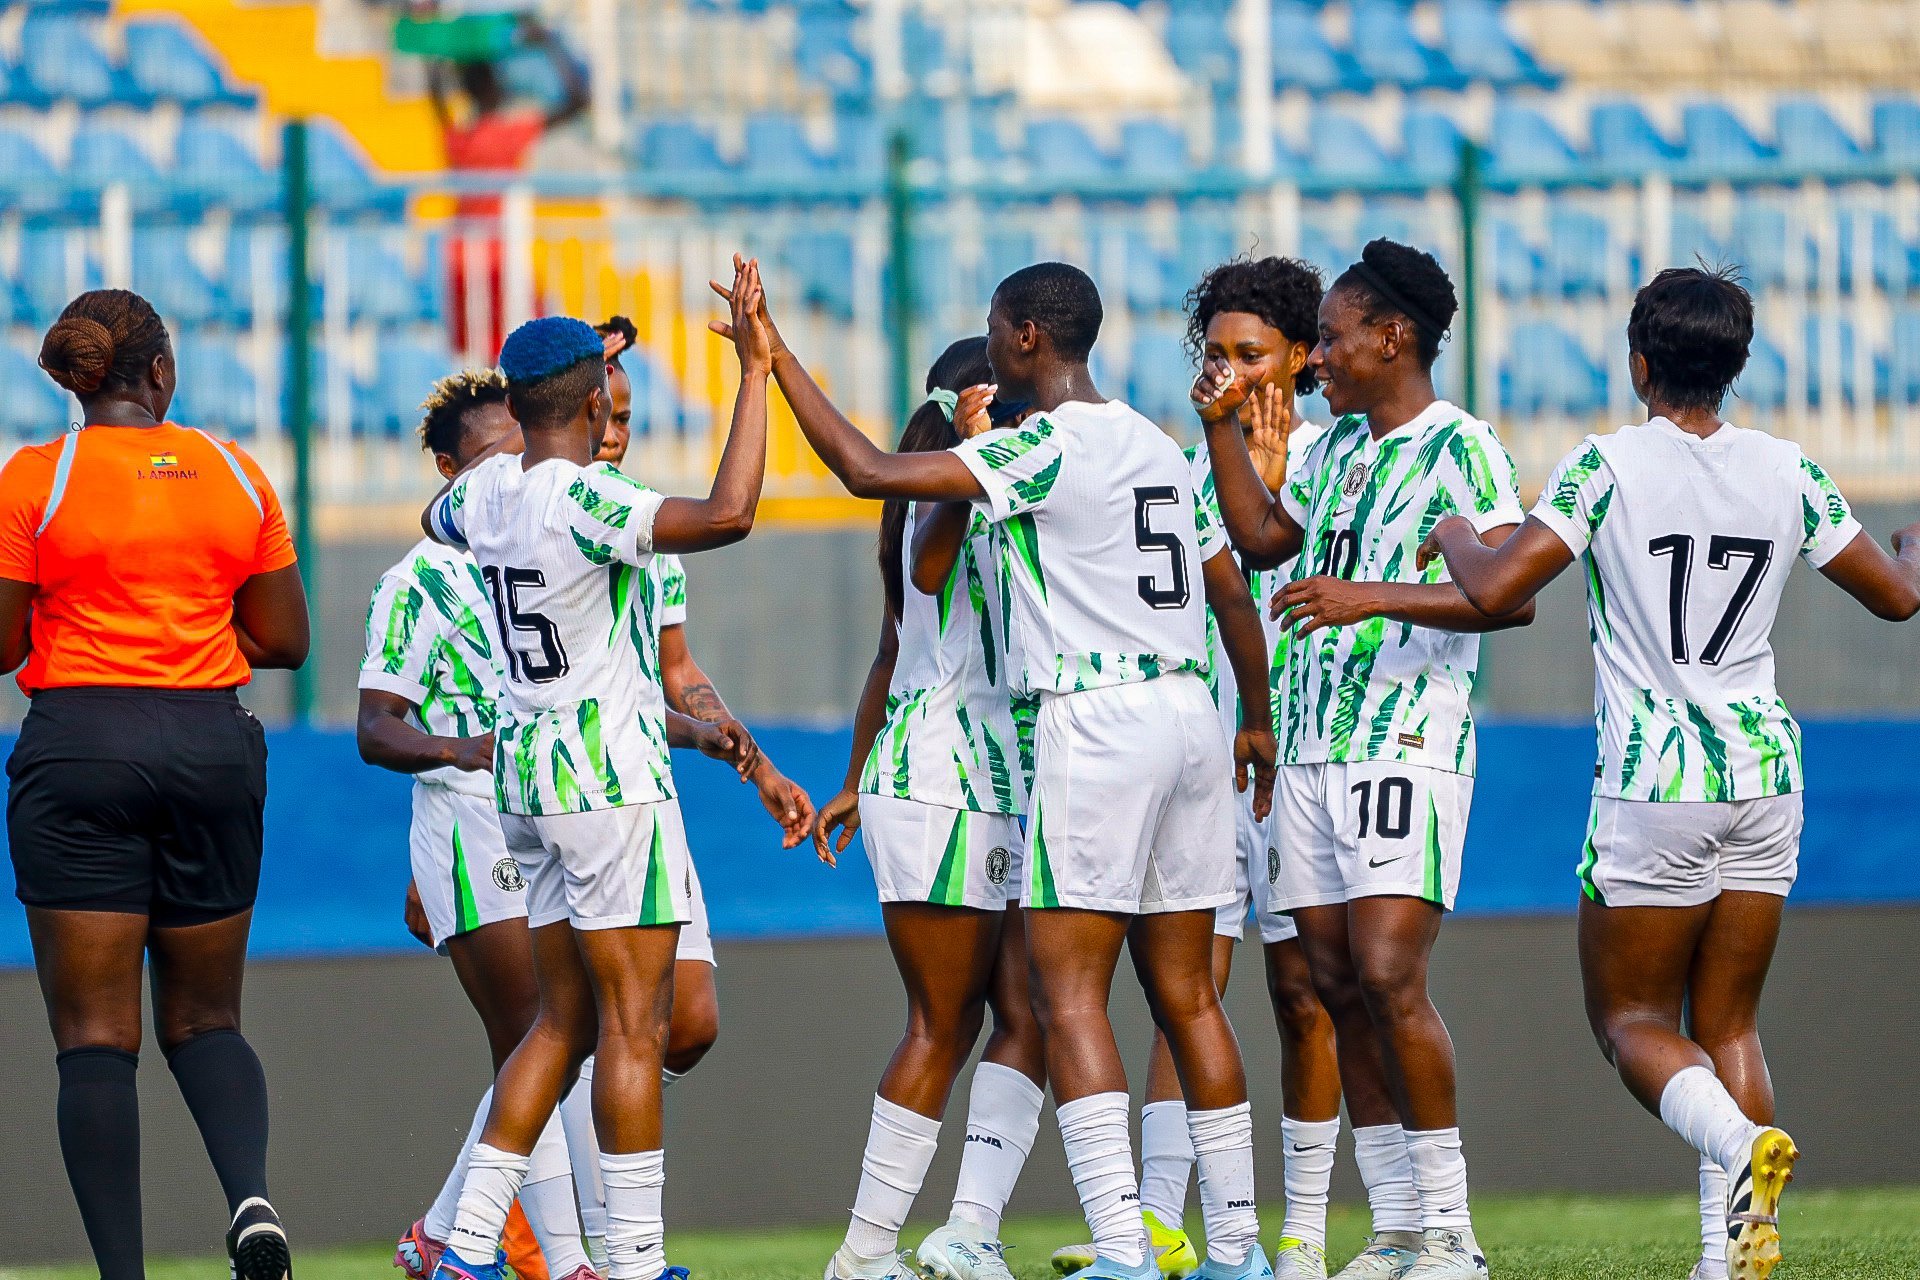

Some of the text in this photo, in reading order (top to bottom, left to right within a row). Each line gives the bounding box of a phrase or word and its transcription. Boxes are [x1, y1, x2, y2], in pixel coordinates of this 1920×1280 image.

[150, 470, 198, 480] APPIAH
[1132, 485, 1190, 610] 5
[1321, 529, 1359, 580] 10
[481, 565, 570, 684] 15
[1648, 534, 1775, 666] 17
[1350, 776, 1414, 840] 10
